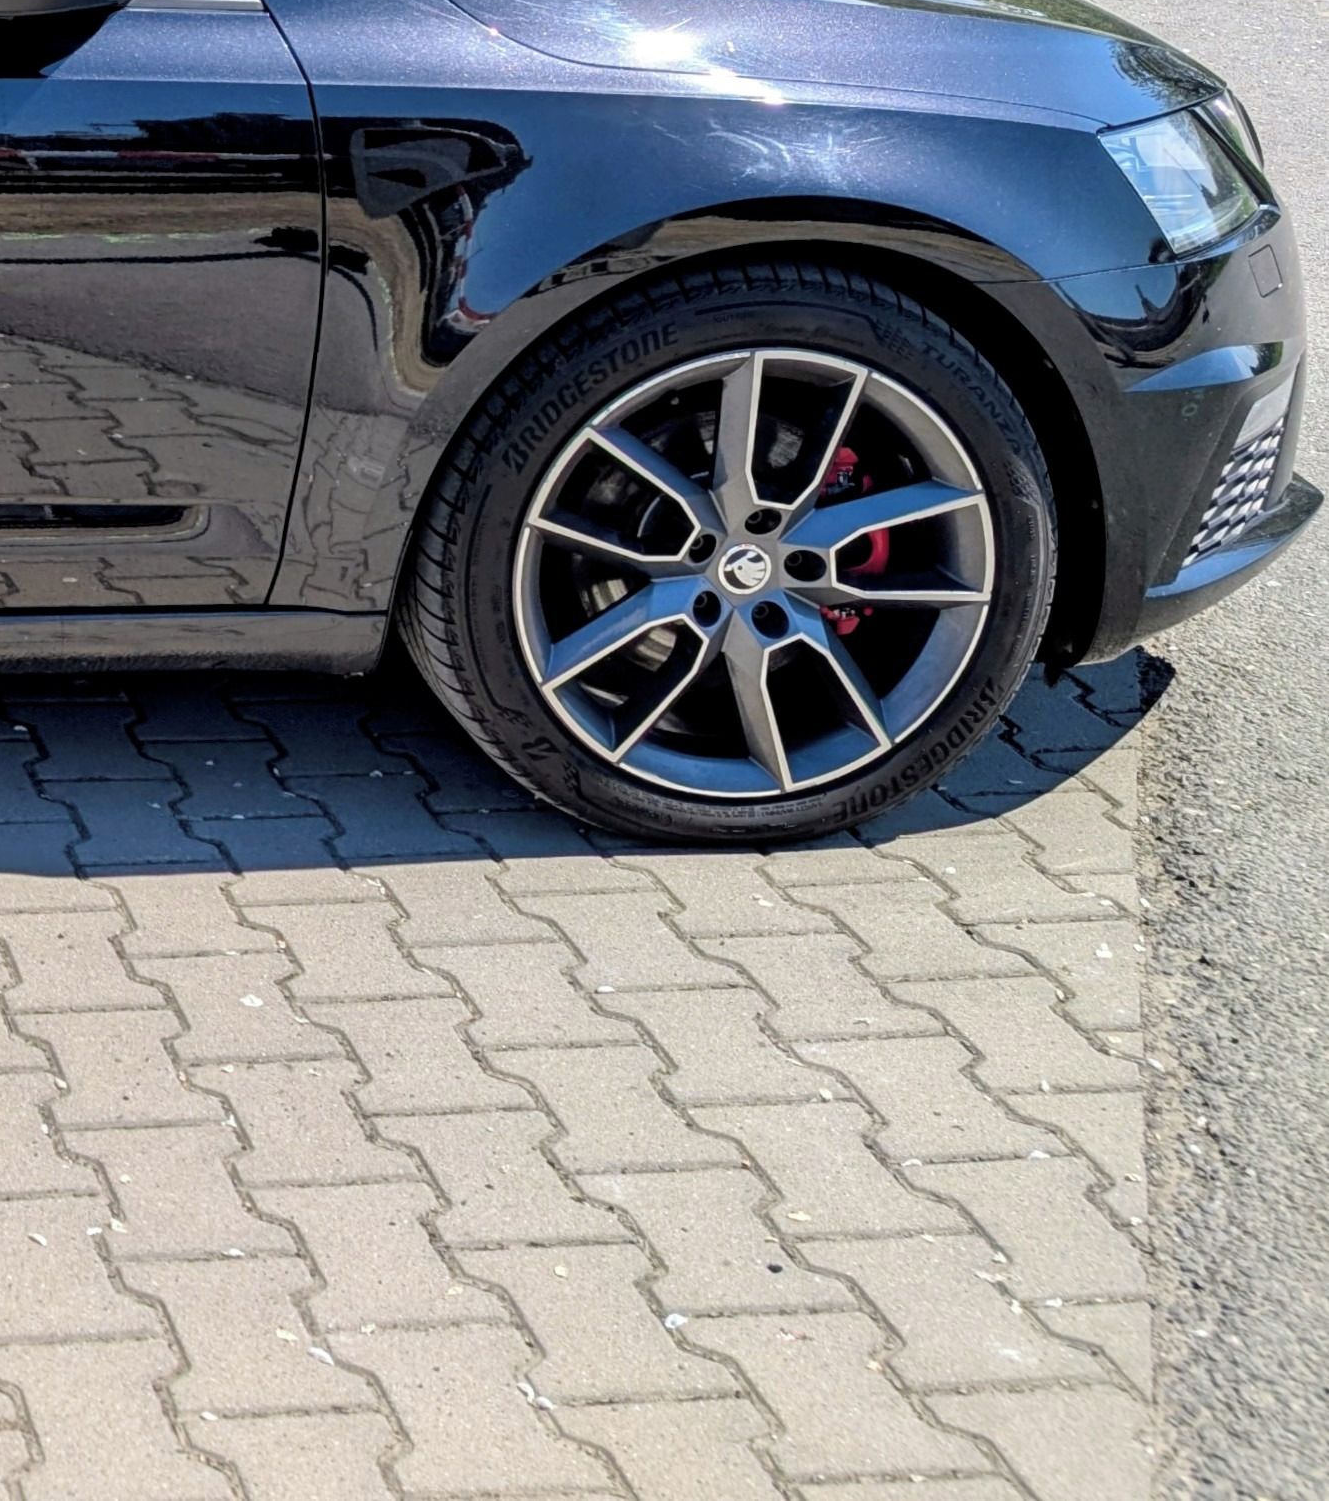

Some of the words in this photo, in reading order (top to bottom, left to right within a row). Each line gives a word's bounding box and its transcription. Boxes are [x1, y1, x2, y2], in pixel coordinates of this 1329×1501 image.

[502, 323, 679, 476] BRIDGESTONE
[922, 341, 1022, 456] TURANZA
[833, 676, 1005, 824] BRIDGESTONE
